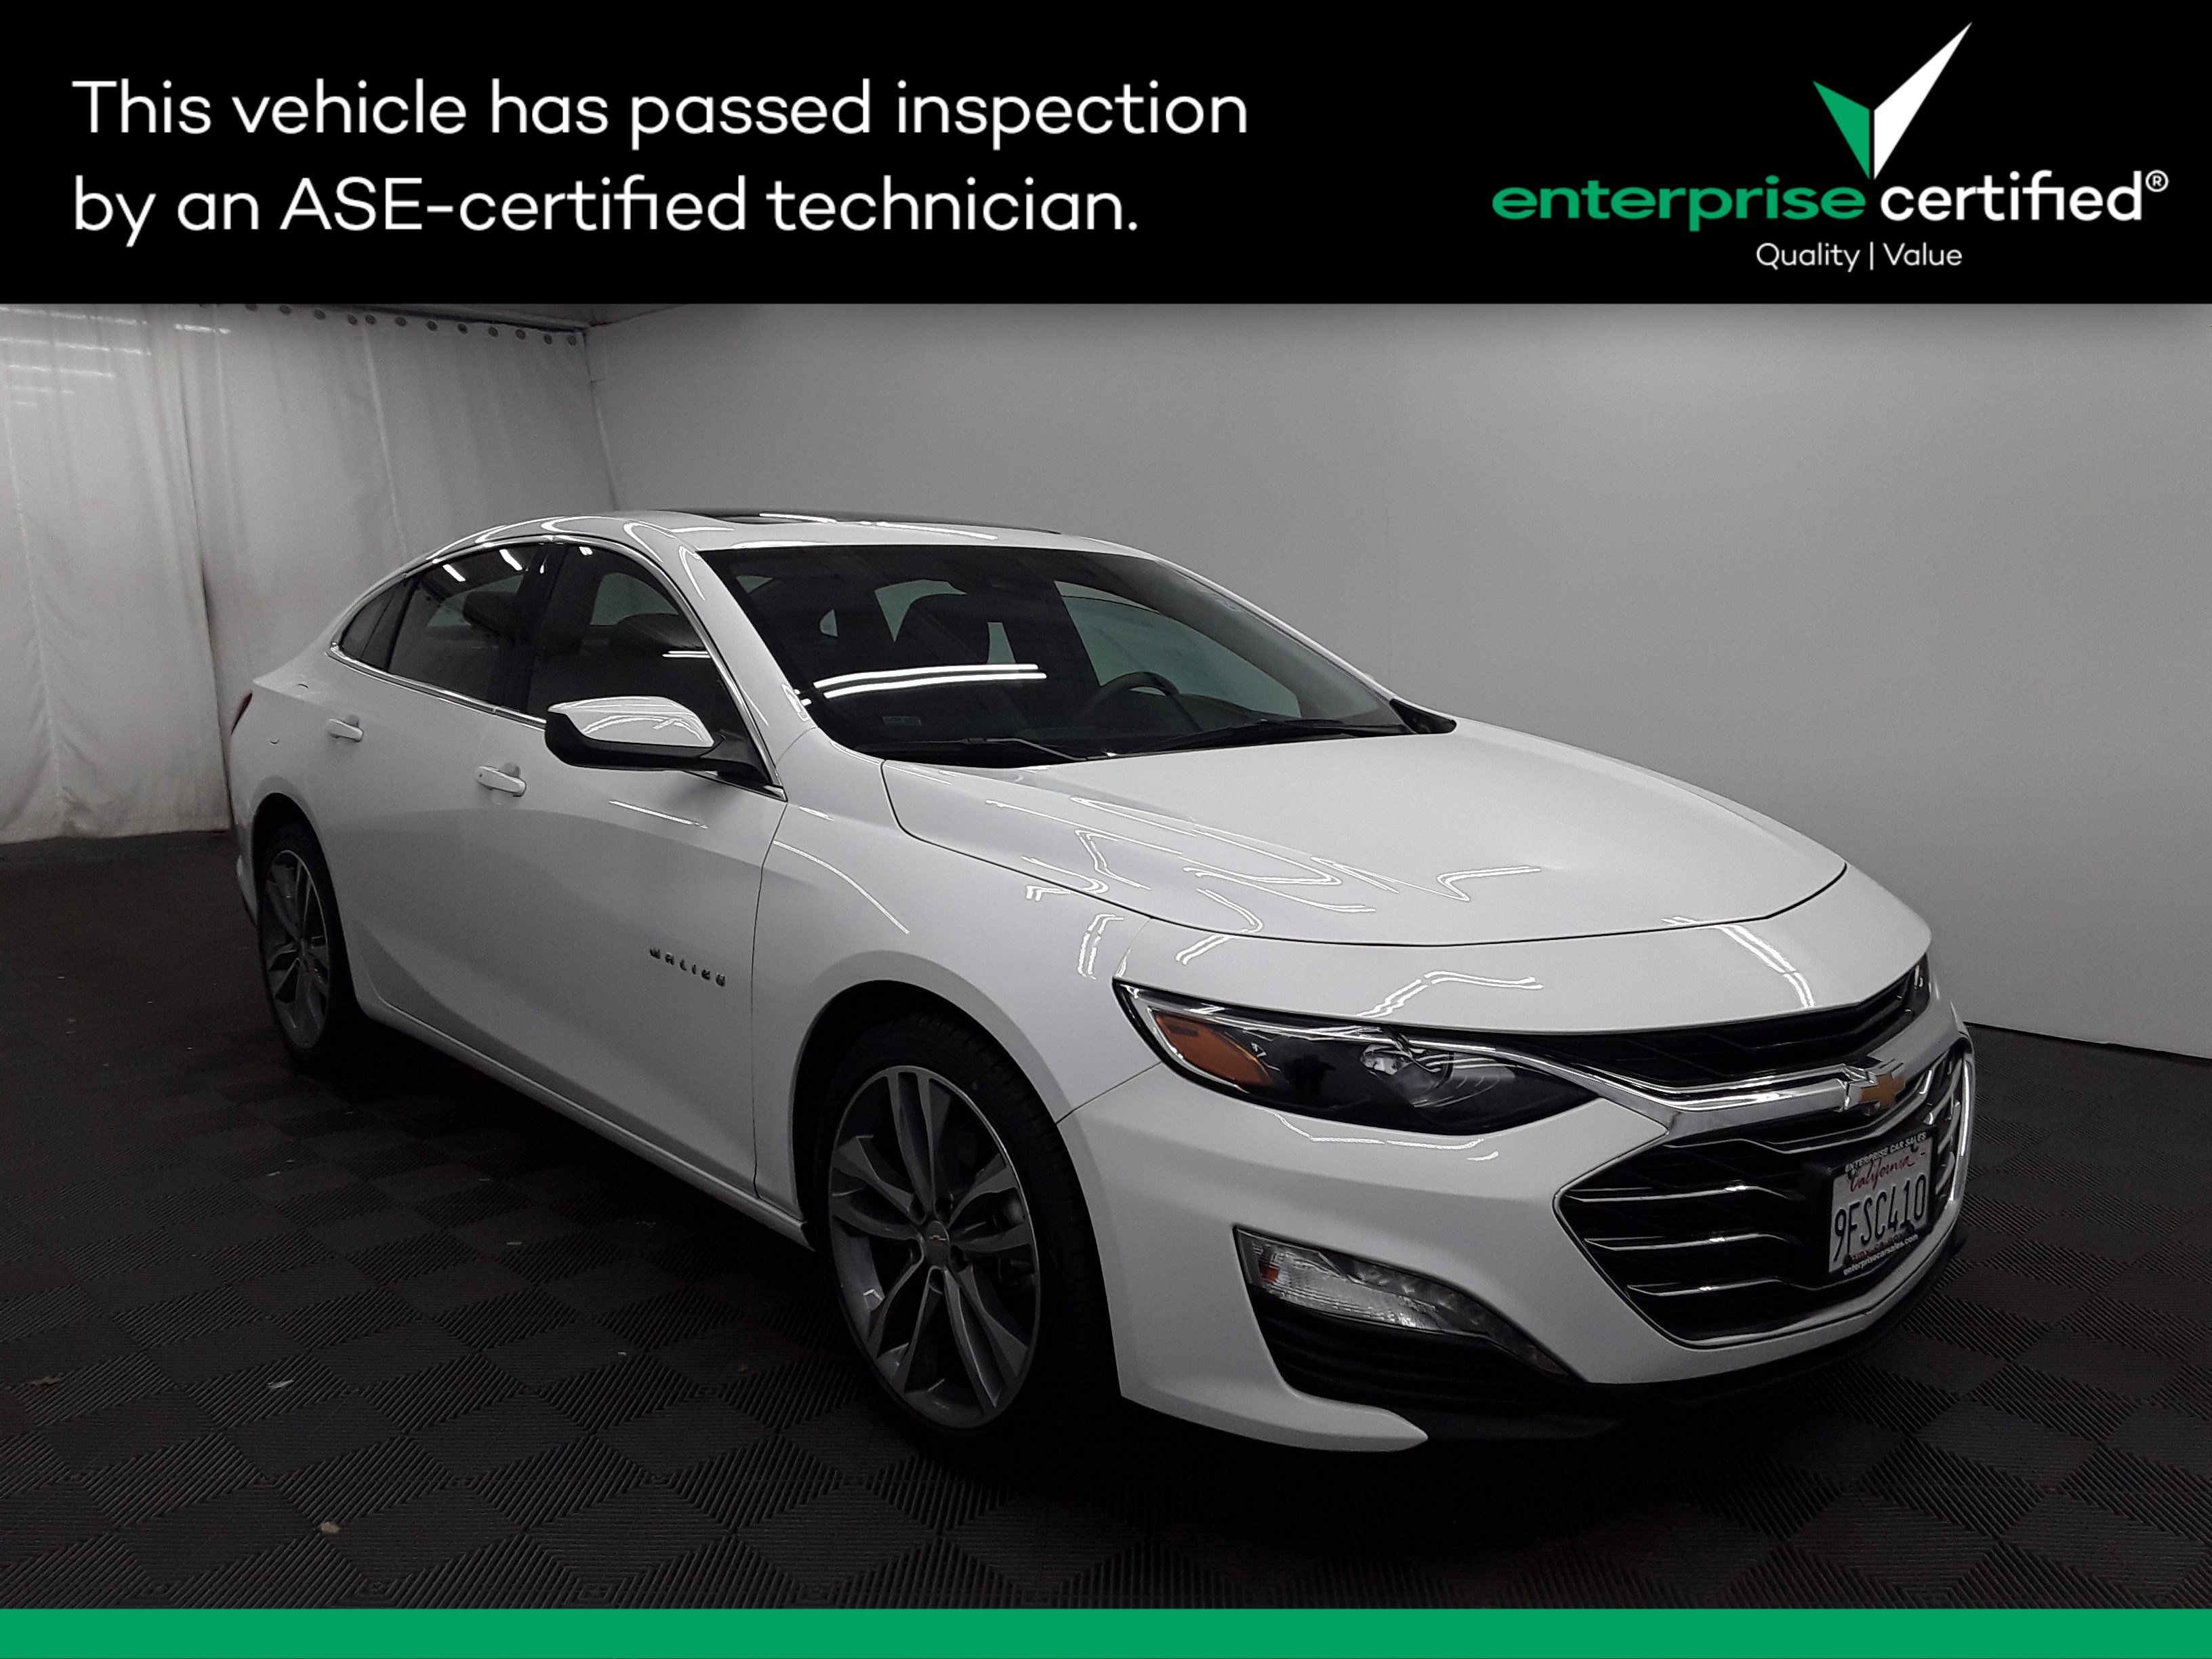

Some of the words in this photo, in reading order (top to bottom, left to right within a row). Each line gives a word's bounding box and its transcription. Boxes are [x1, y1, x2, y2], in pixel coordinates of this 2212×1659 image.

[649, 947, 726, 987] MALIBU
[1849, 1155, 1915, 1192] California
[1833, 1174, 1926, 1263] 9FSC410
